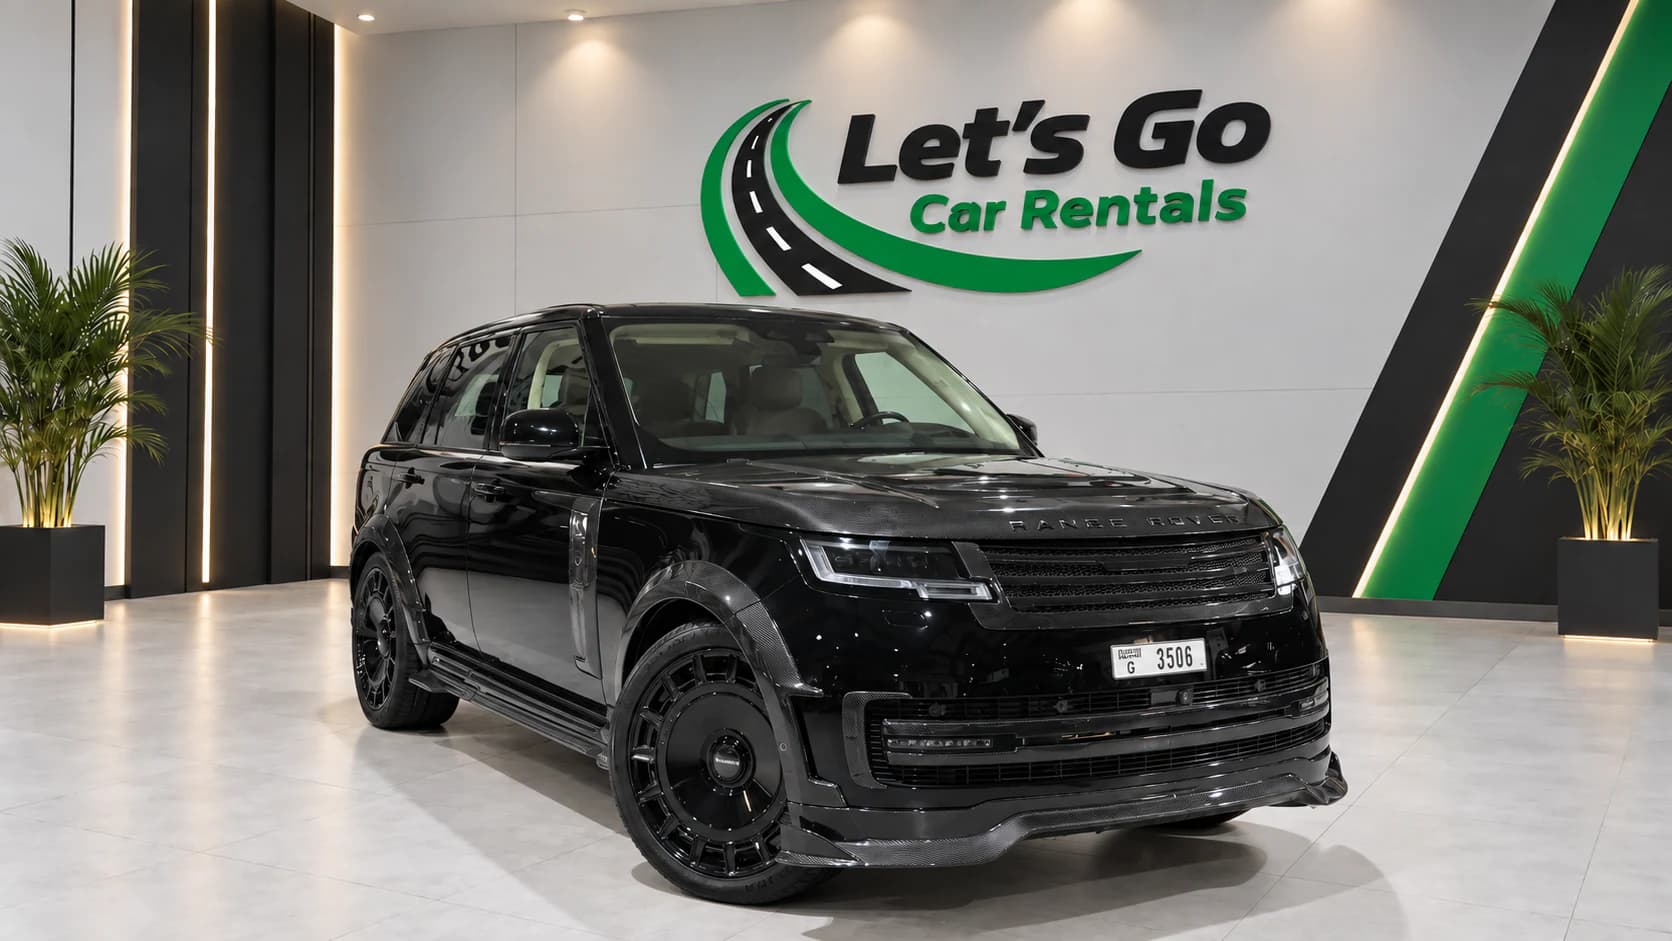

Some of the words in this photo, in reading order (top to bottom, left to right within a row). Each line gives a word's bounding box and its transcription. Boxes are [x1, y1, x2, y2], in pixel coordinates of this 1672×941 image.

[838, 100, 1090, 184] Let's
[1114, 90, 1271, 169] Go
[910, 194, 1007, 233] Car
[1021, 179, 1247, 230] Rentals
[1008, 518, 1128, 532] RANGE
[1145, 514, 1240, 527] ROVER
[1127, 661, 1136, 674] G
[1157, 646, 1193, 670] 3506
